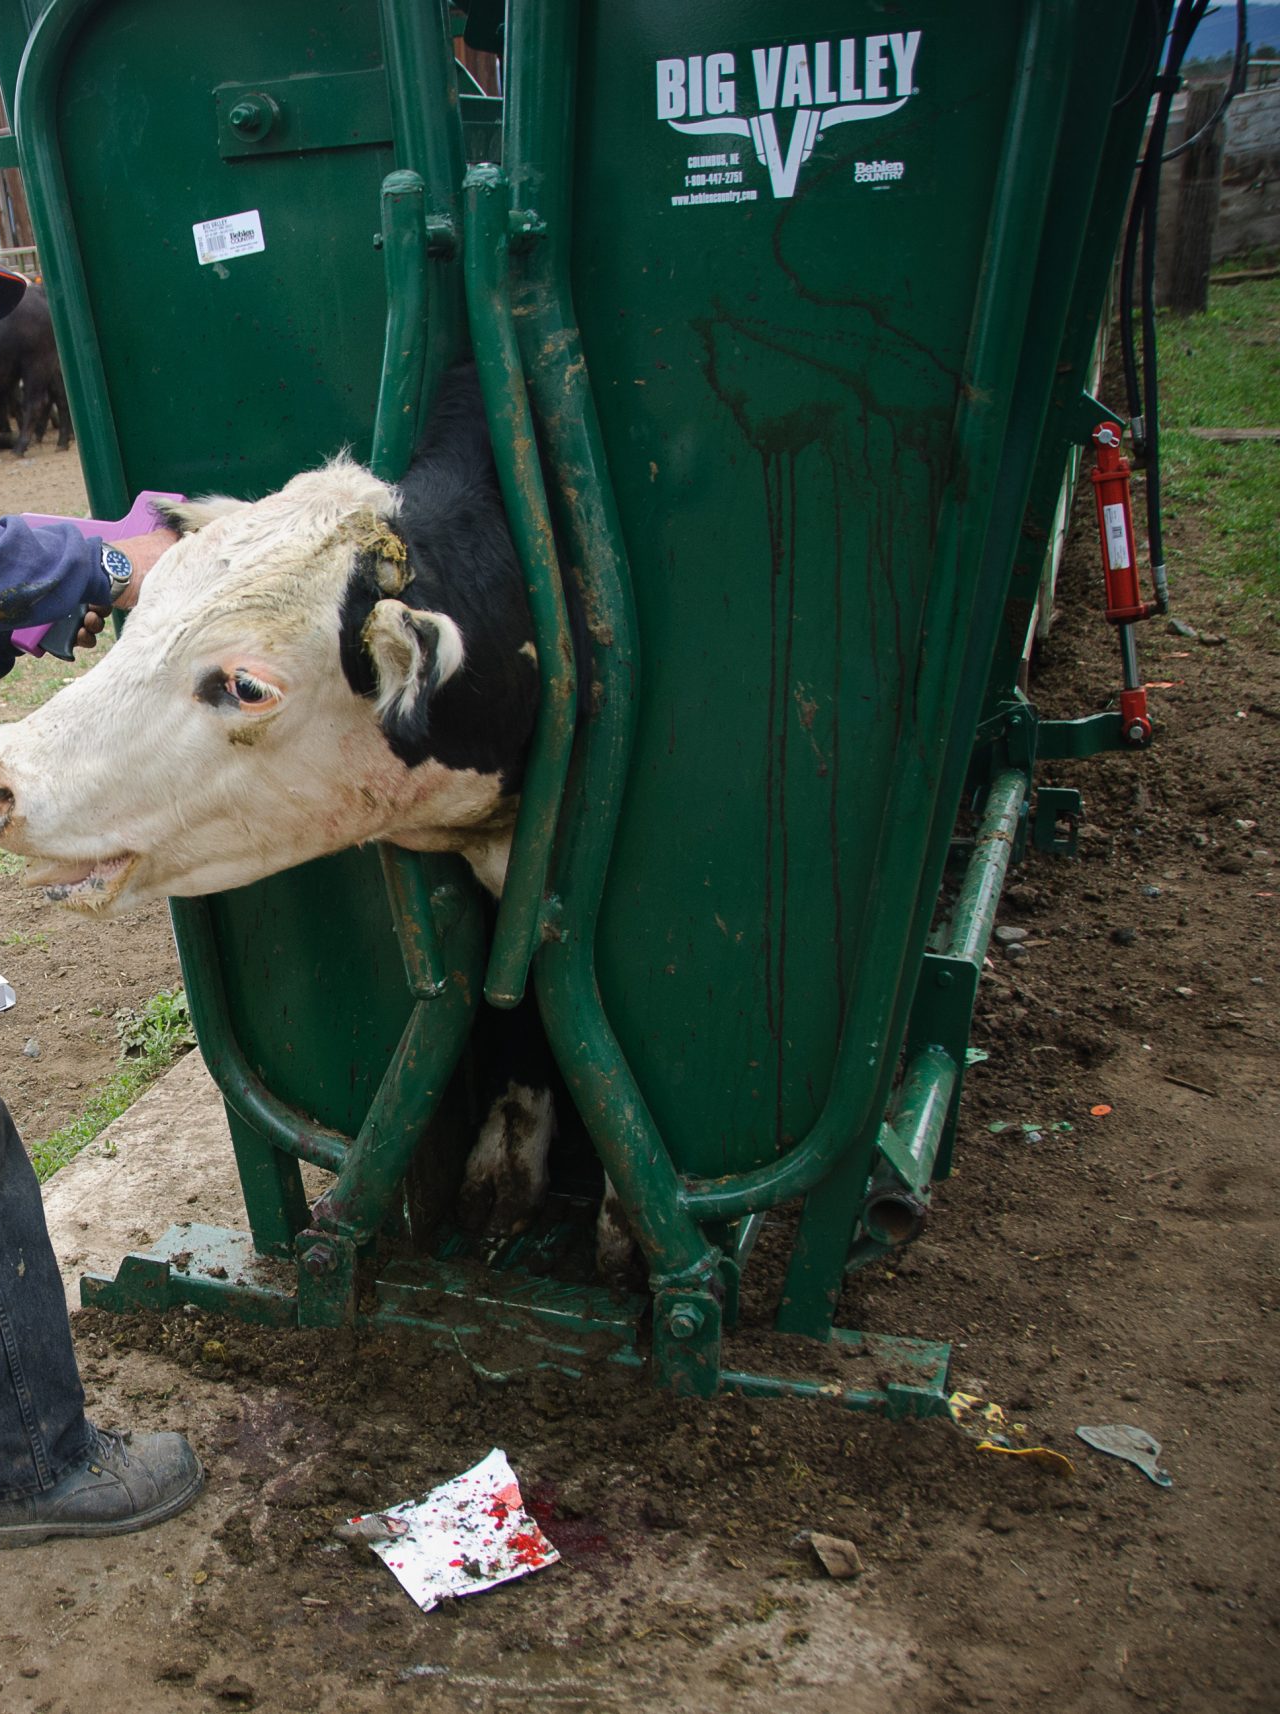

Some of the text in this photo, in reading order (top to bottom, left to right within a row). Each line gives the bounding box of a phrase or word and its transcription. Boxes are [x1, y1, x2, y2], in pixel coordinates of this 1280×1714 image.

[656, 30, 921, 120] BIG VALLEY
[687, 152, 741, 169] COLUMBUS, NE
[854, 160, 904, 174] Behlen
[684, 171, 743, 188] 1-800-447-2751
[854, 171, 903, 182] COUNTRY
